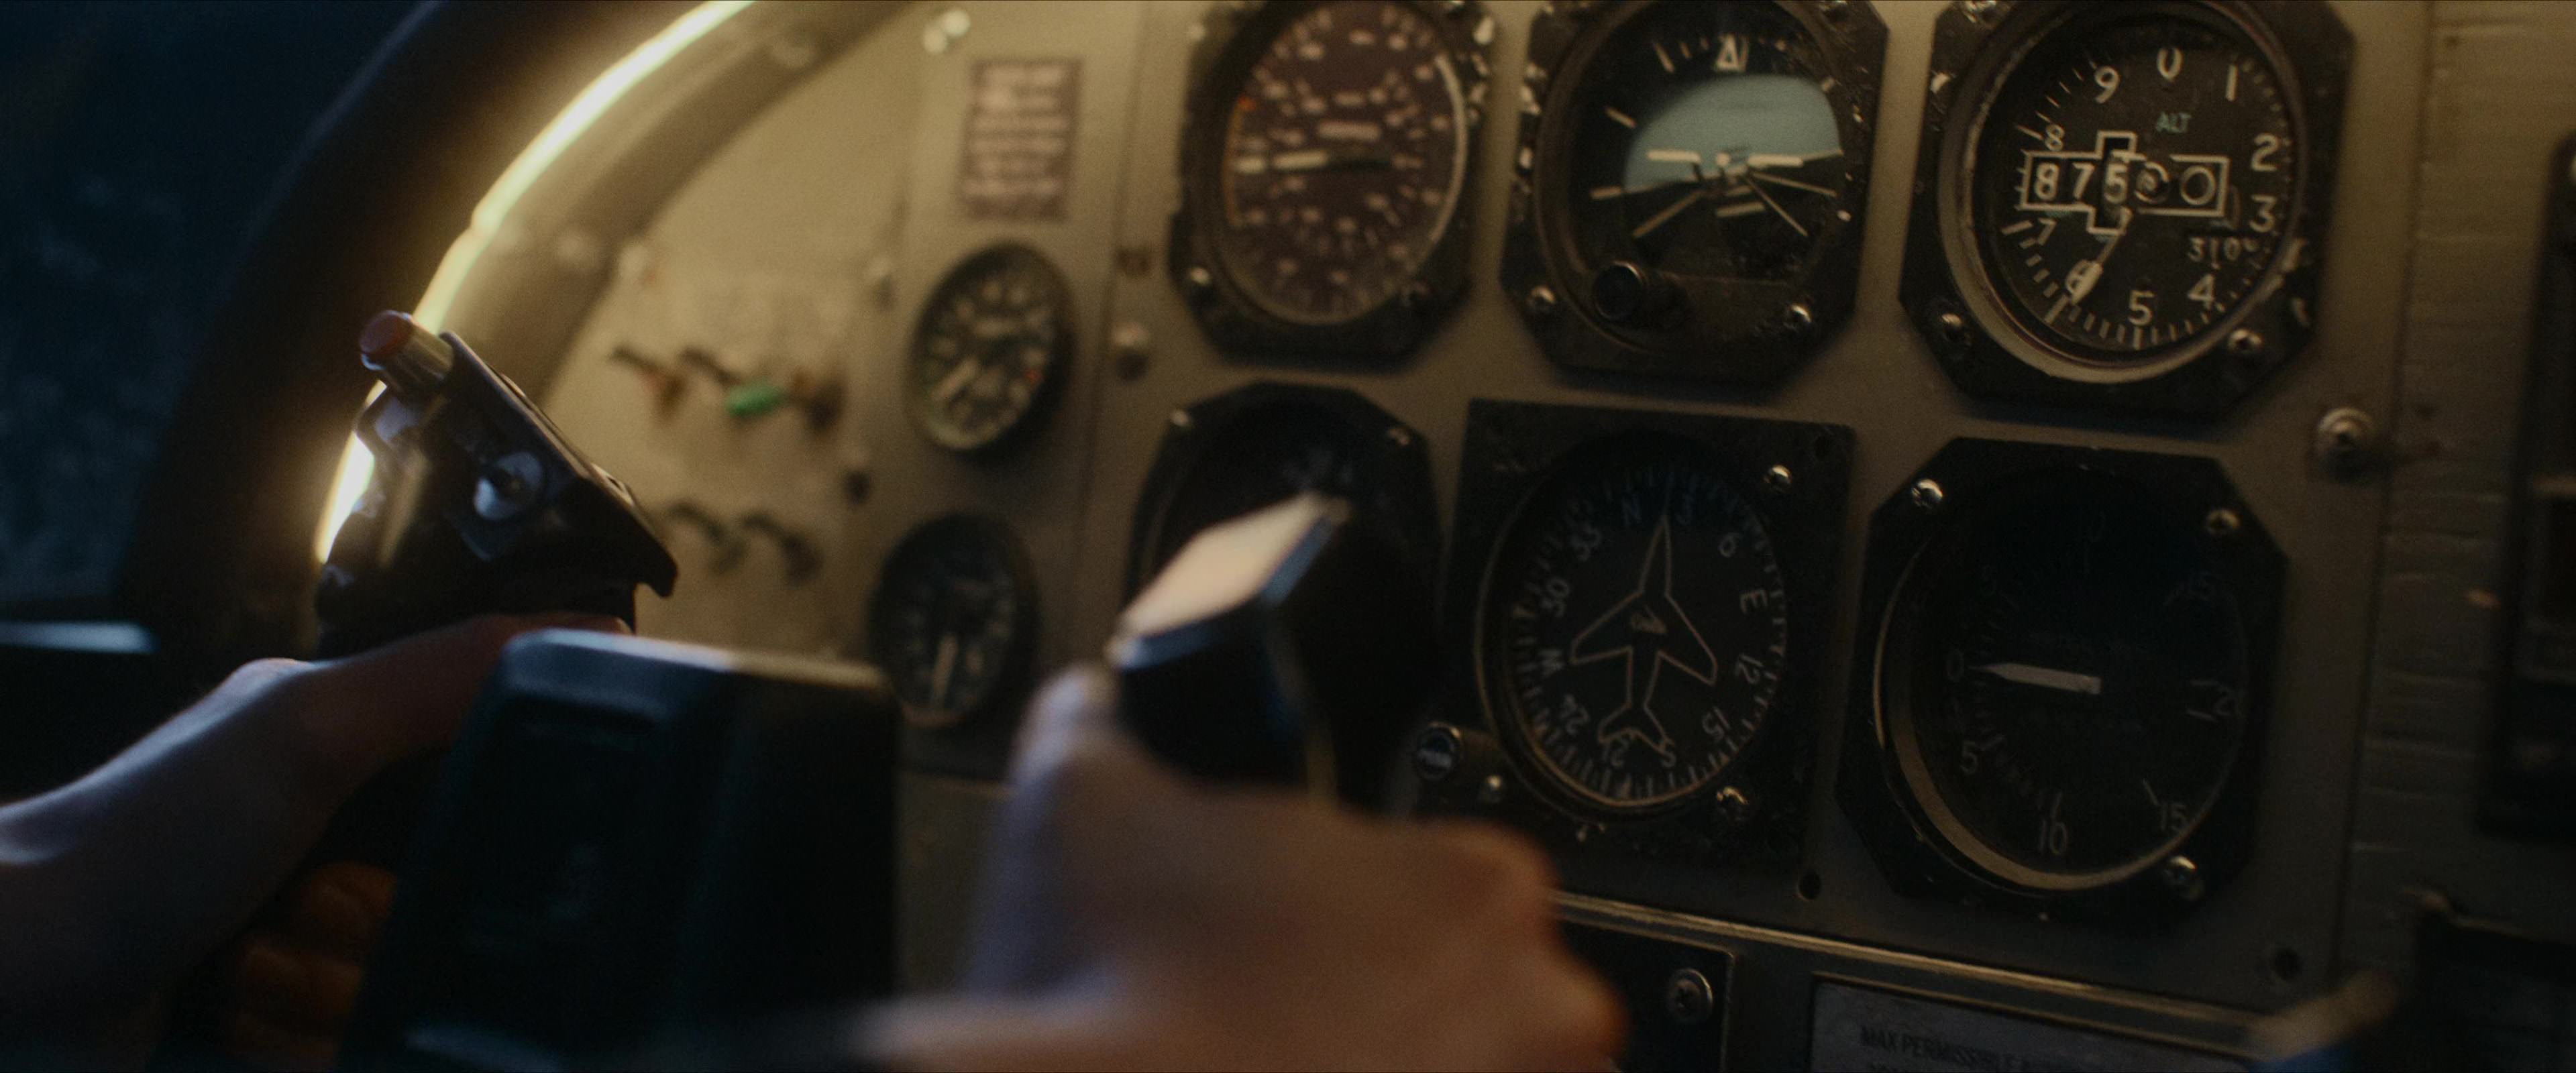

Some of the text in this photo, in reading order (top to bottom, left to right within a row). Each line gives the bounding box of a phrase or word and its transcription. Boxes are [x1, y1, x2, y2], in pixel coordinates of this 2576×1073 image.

[2156, 47, 2184, 81] 0
[2094, 66, 2120, 103] 9
[2224, 65, 2239, 101] 1
[2045, 123, 2065, 152] 8
[2155, 111, 2192, 133] ALT
[2251, 133, 2280, 171] 2
[2249, 195, 2276, 233] 3
[2037, 217, 2057, 247] 7
[2129, 290, 2155, 326] 5
[2188, 273, 2215, 310] 4
[1717, 532, 1743, 559] 6
[1739, 587, 1769, 615] E
[1733, 653, 1764, 685] 12
[1946, 648, 1965, 683] 0
[1701, 705, 1732, 741] 15
[1960, 740, 1979, 775] 5
[1860, 1025, 1898, 1054] MAX
